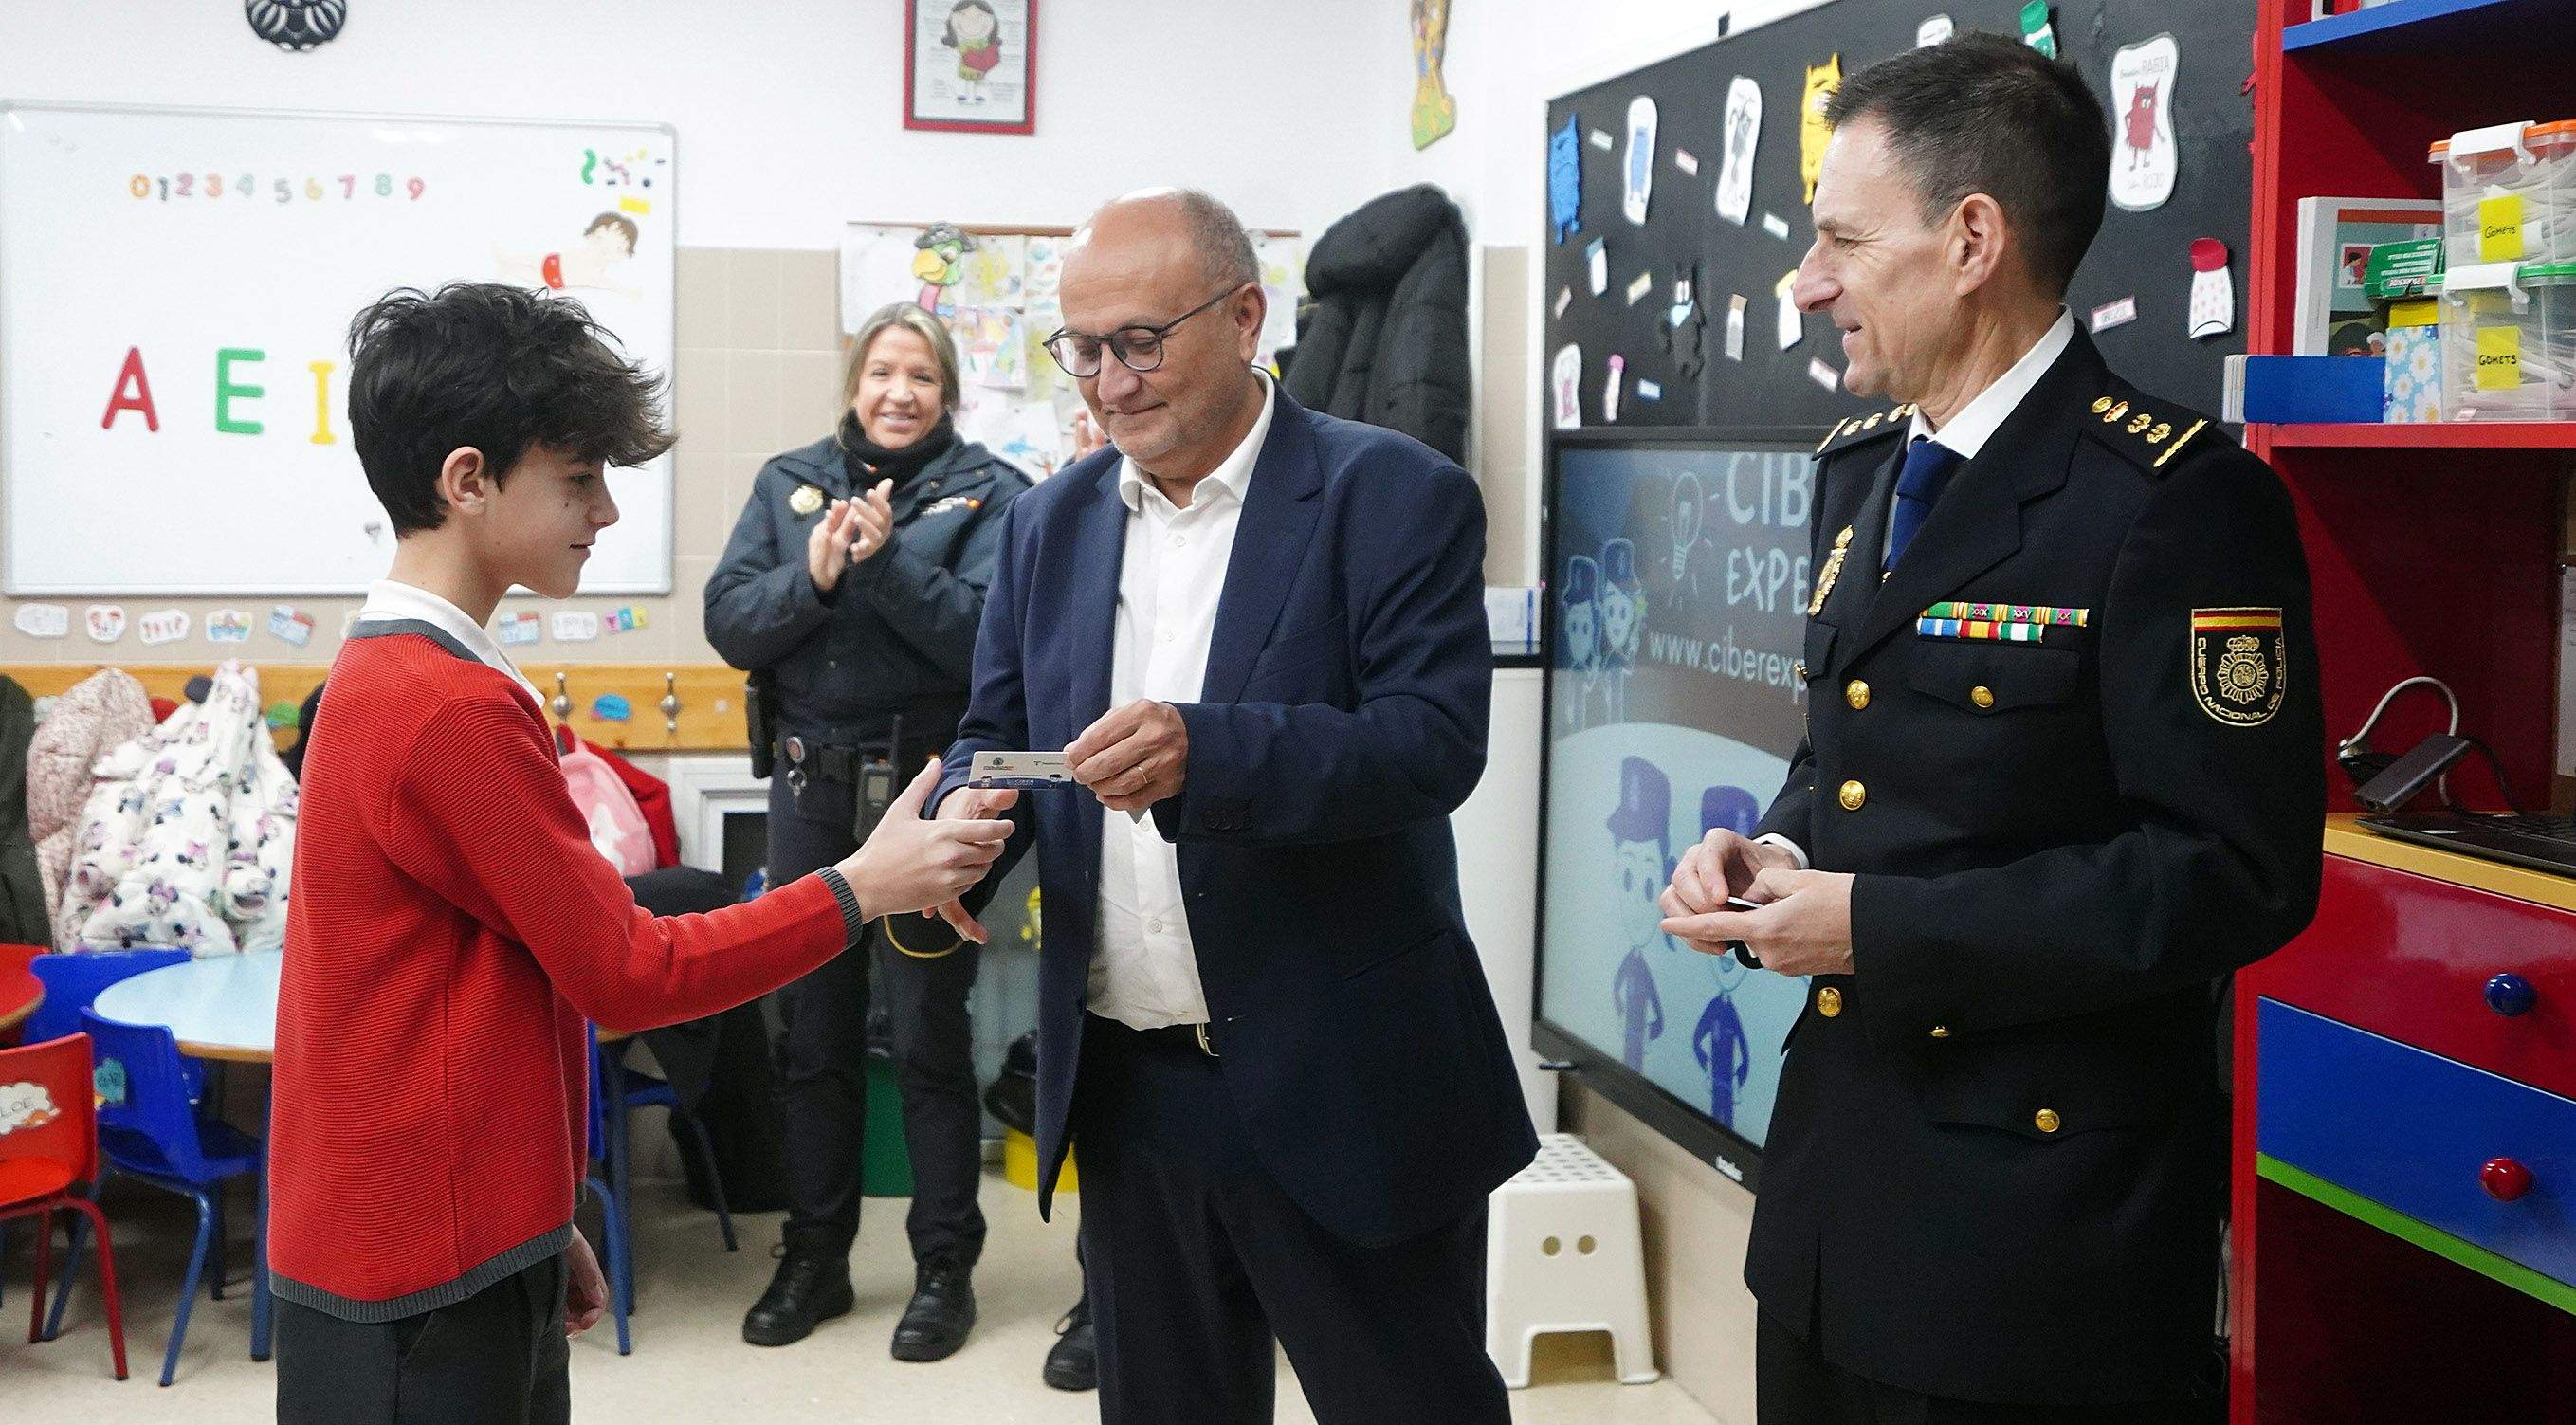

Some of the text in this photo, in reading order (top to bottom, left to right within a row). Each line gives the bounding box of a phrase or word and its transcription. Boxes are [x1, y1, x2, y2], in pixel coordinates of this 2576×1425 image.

[100, 346, 338, 445] A E I
